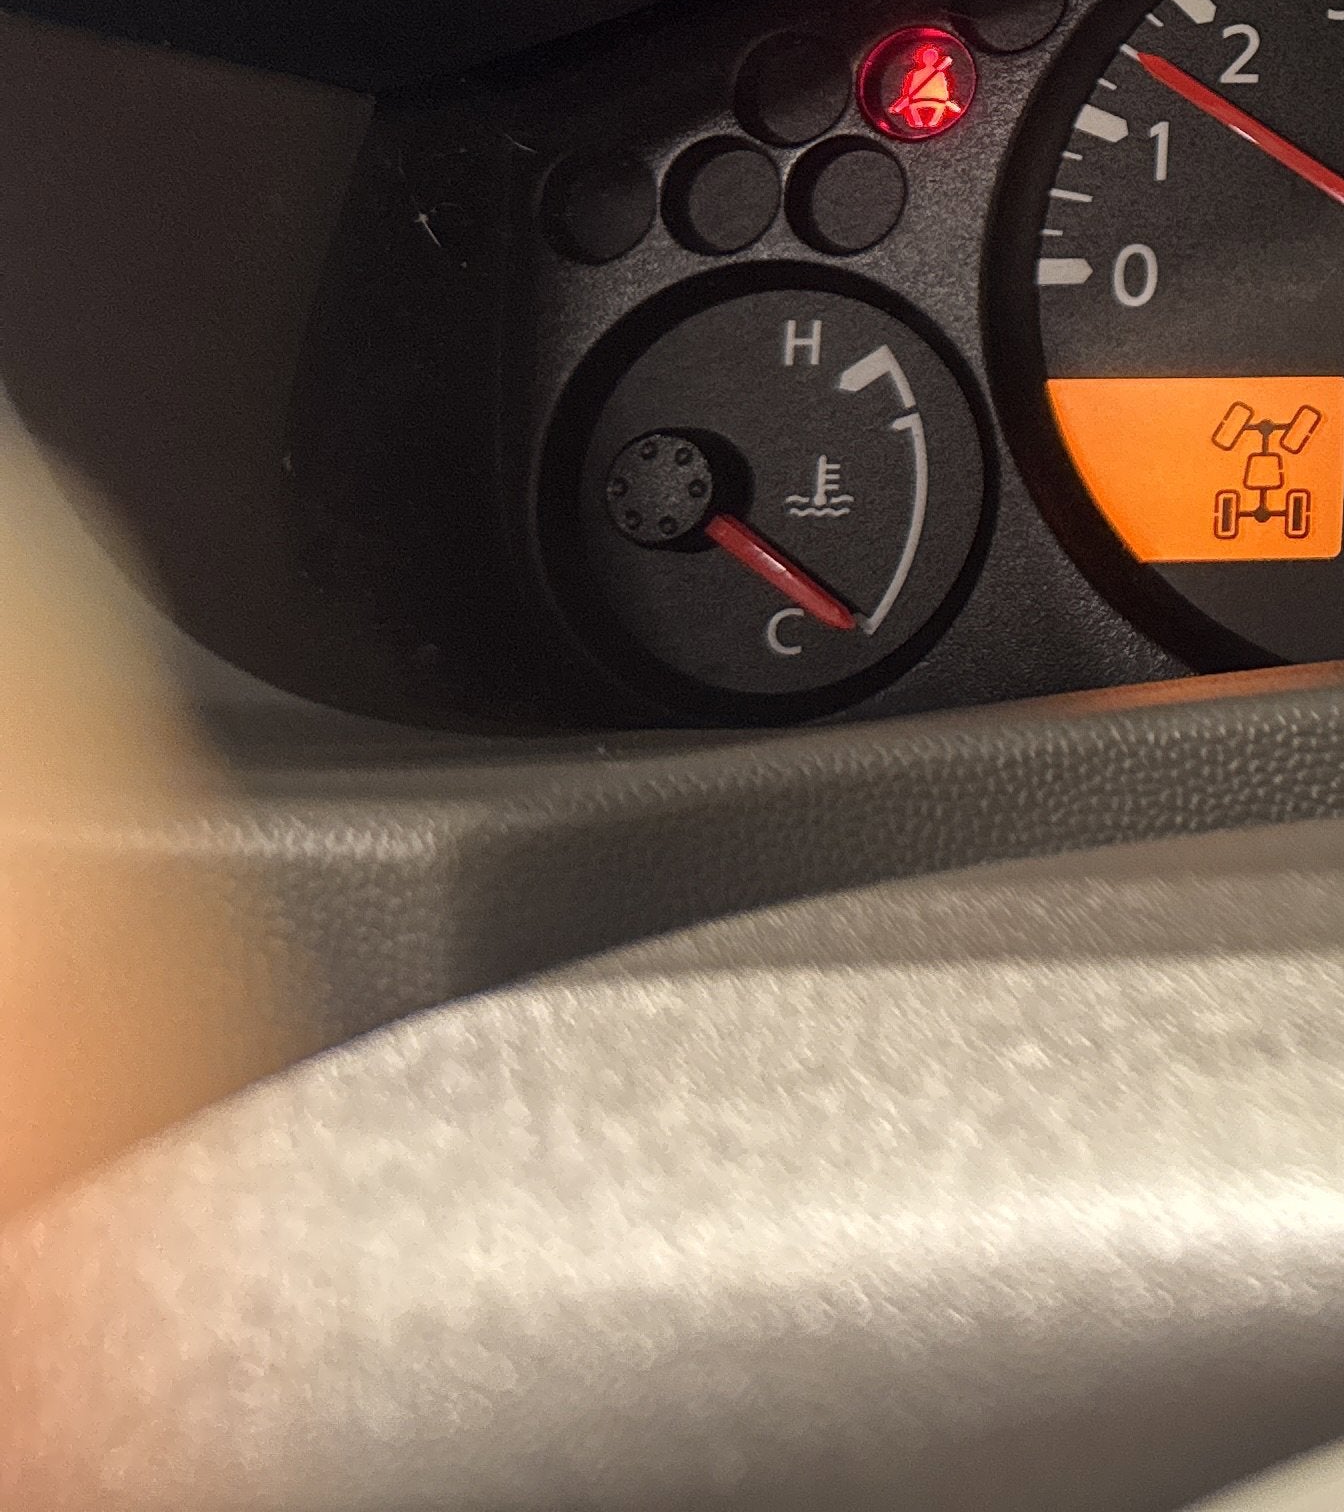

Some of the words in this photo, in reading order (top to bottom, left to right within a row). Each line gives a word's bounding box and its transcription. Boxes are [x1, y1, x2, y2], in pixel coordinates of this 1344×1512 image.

[1219, 23, 1260, 84] 2
[1149, 121, 1169, 181] 1
[1113, 243, 1158, 308] 0
[783, 319, 822, 366] H
[766, 608, 804, 656] C
